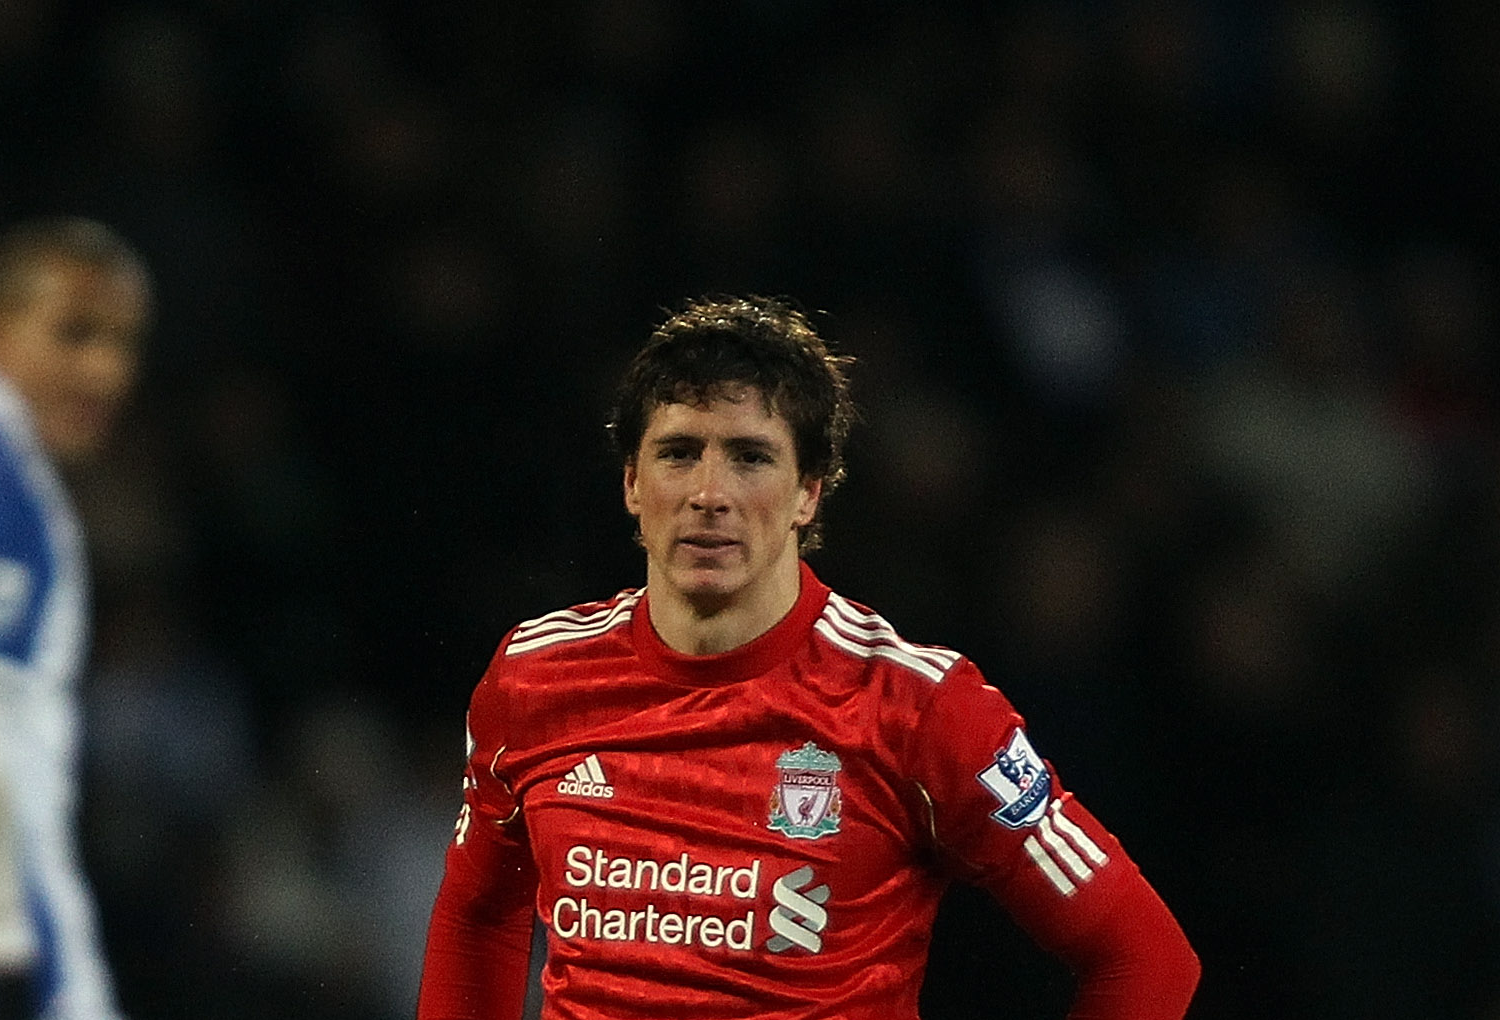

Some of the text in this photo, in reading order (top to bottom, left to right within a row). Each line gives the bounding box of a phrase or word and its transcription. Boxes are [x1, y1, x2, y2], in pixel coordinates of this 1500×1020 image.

[557, 779, 615, 798] adidas
[783, 774, 832, 786] LIVERPOOL
[565, 845, 760, 898] Standard
[553, 896, 754, 950] Chartered
